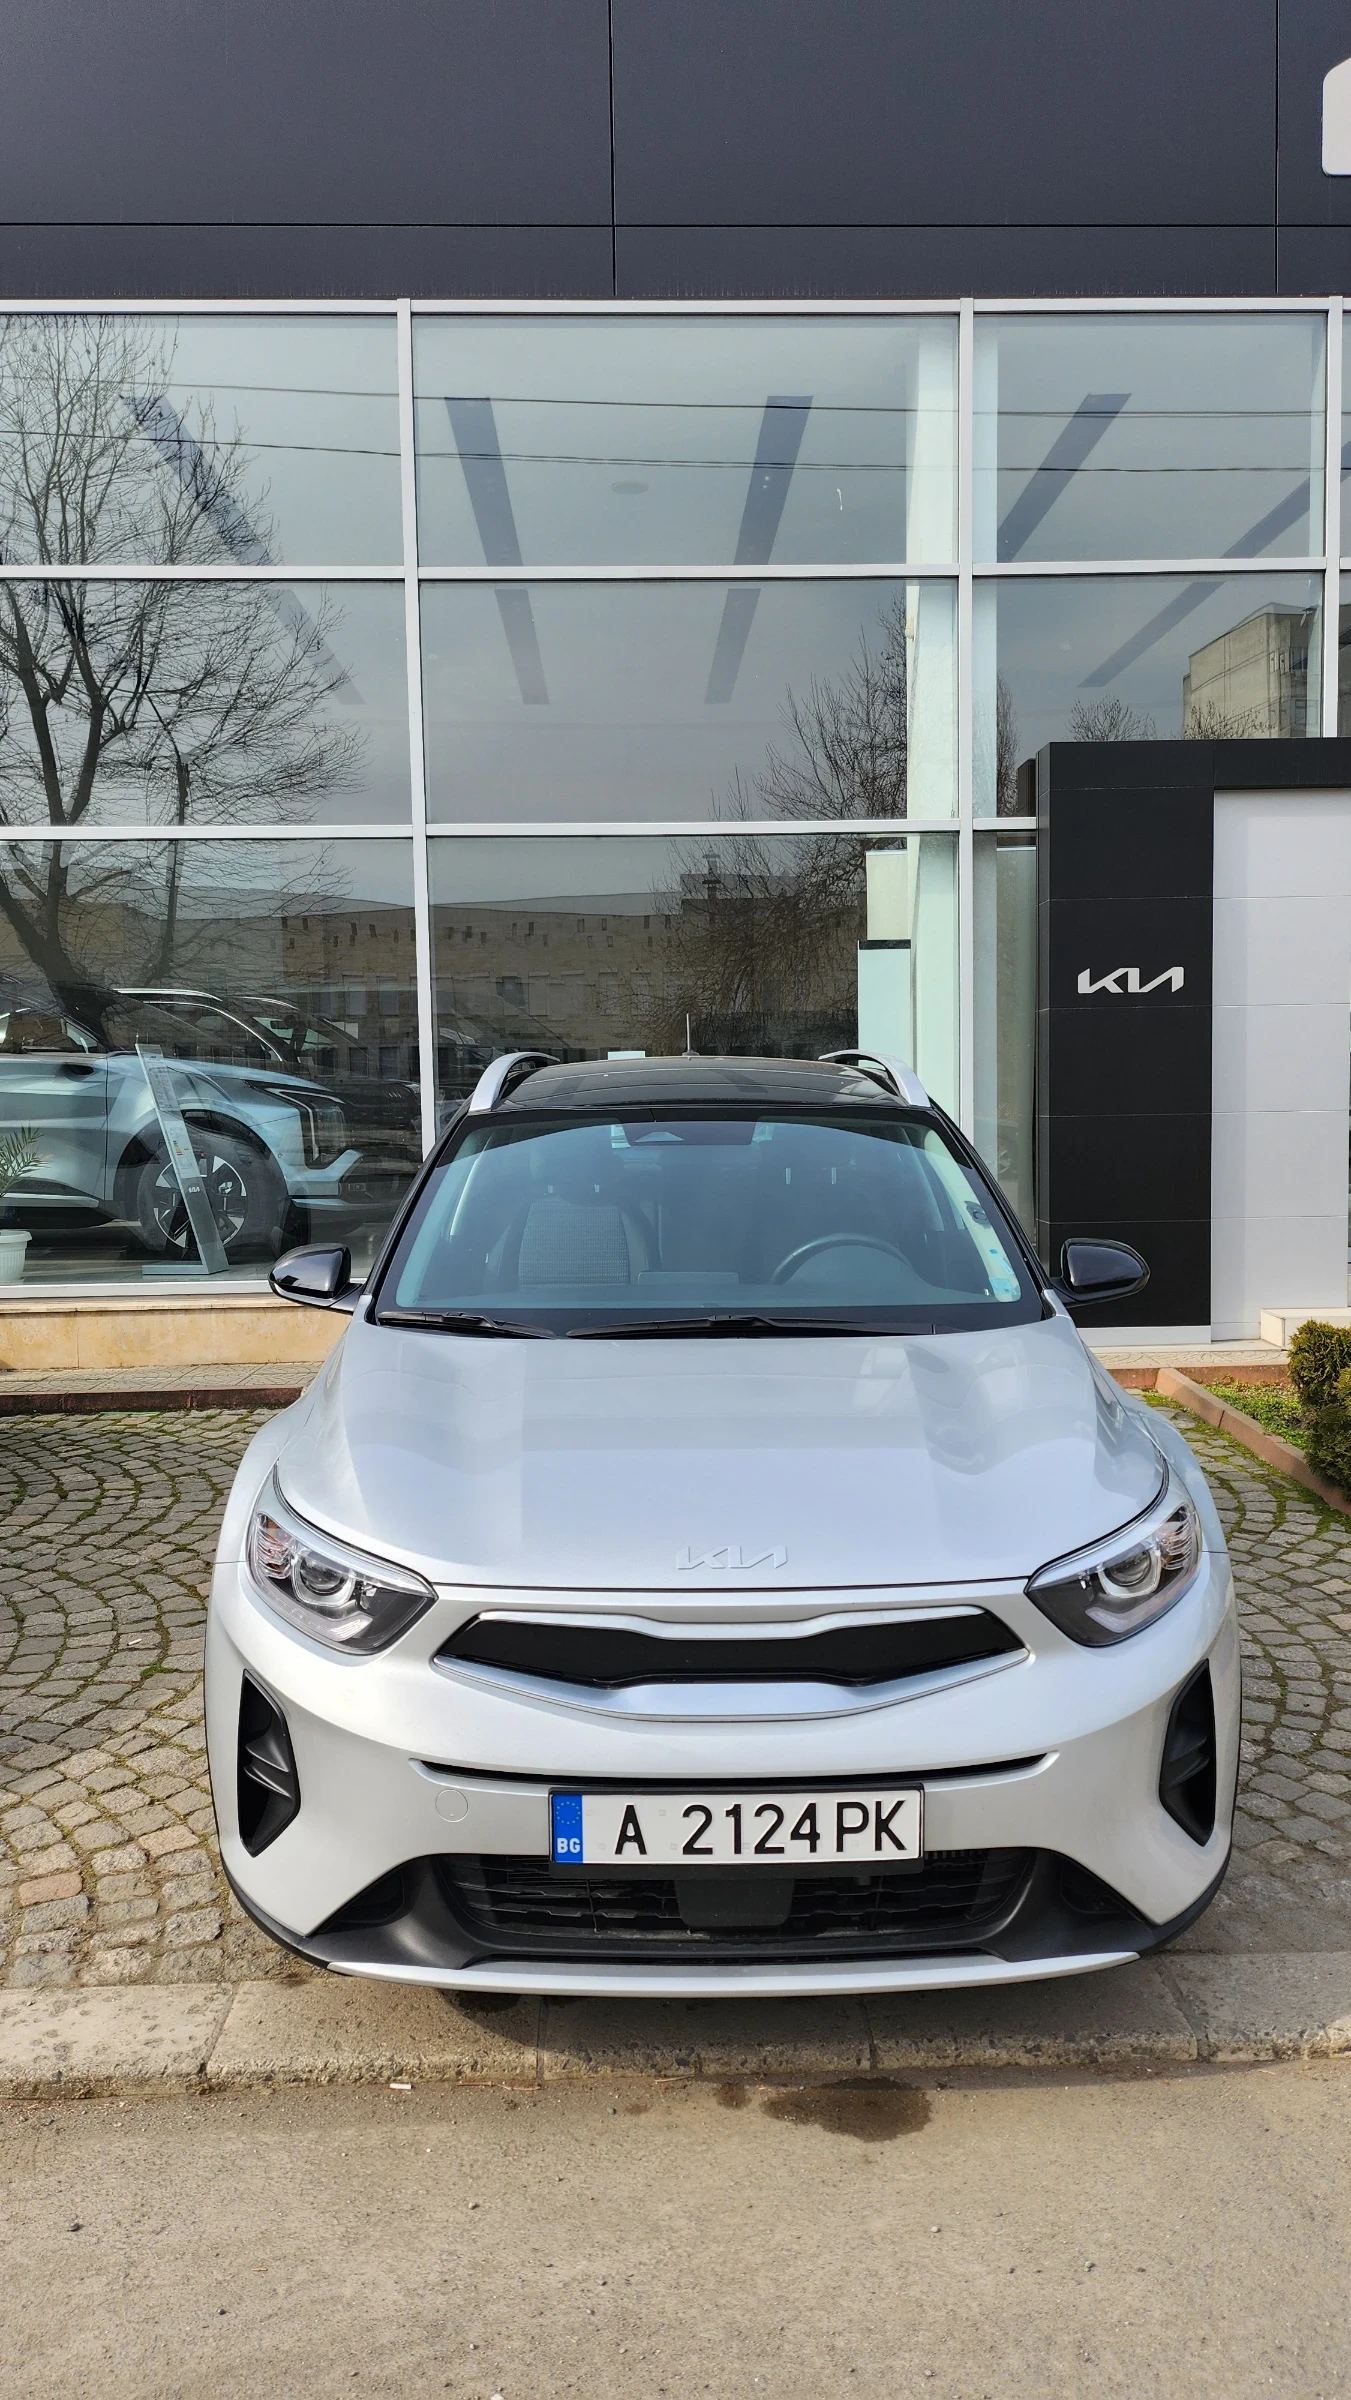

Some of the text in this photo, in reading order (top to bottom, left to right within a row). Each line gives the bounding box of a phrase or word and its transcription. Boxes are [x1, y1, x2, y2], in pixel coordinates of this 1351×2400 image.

[1077, 966, 1185, 994] KIA
[676, 1545, 789, 1571] KIA
[614, 1803, 648, 1856] A
[556, 1837, 581, 1854] BG
